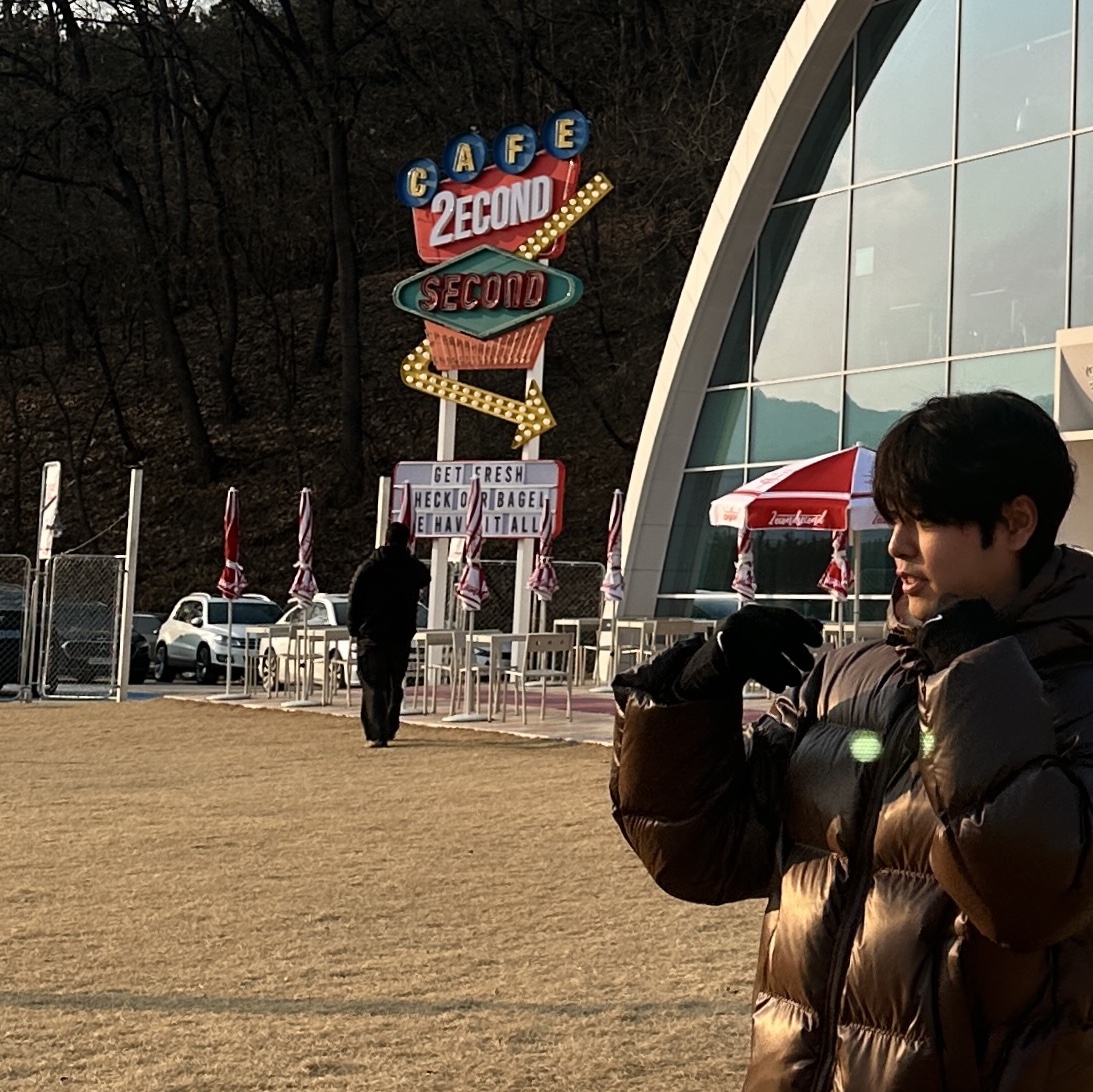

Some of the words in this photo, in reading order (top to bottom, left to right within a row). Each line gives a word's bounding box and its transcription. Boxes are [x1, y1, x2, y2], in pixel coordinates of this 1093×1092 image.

[408, 118, 574, 197] CAFE
[429, 175, 553, 247] 2ECOND
[418, 270, 547, 313] SECOND
[434, 465, 463, 483] GET
[475, 465, 523, 483] FRESH
[409, 491, 451, 508] HECK
[460, 491, 487, 508] OR
[497, 491, 546, 508] BAGEL
[434, 516, 464, 533] HAV
[485, 516, 500, 533] IT
[511, 516, 538, 533] ALL
